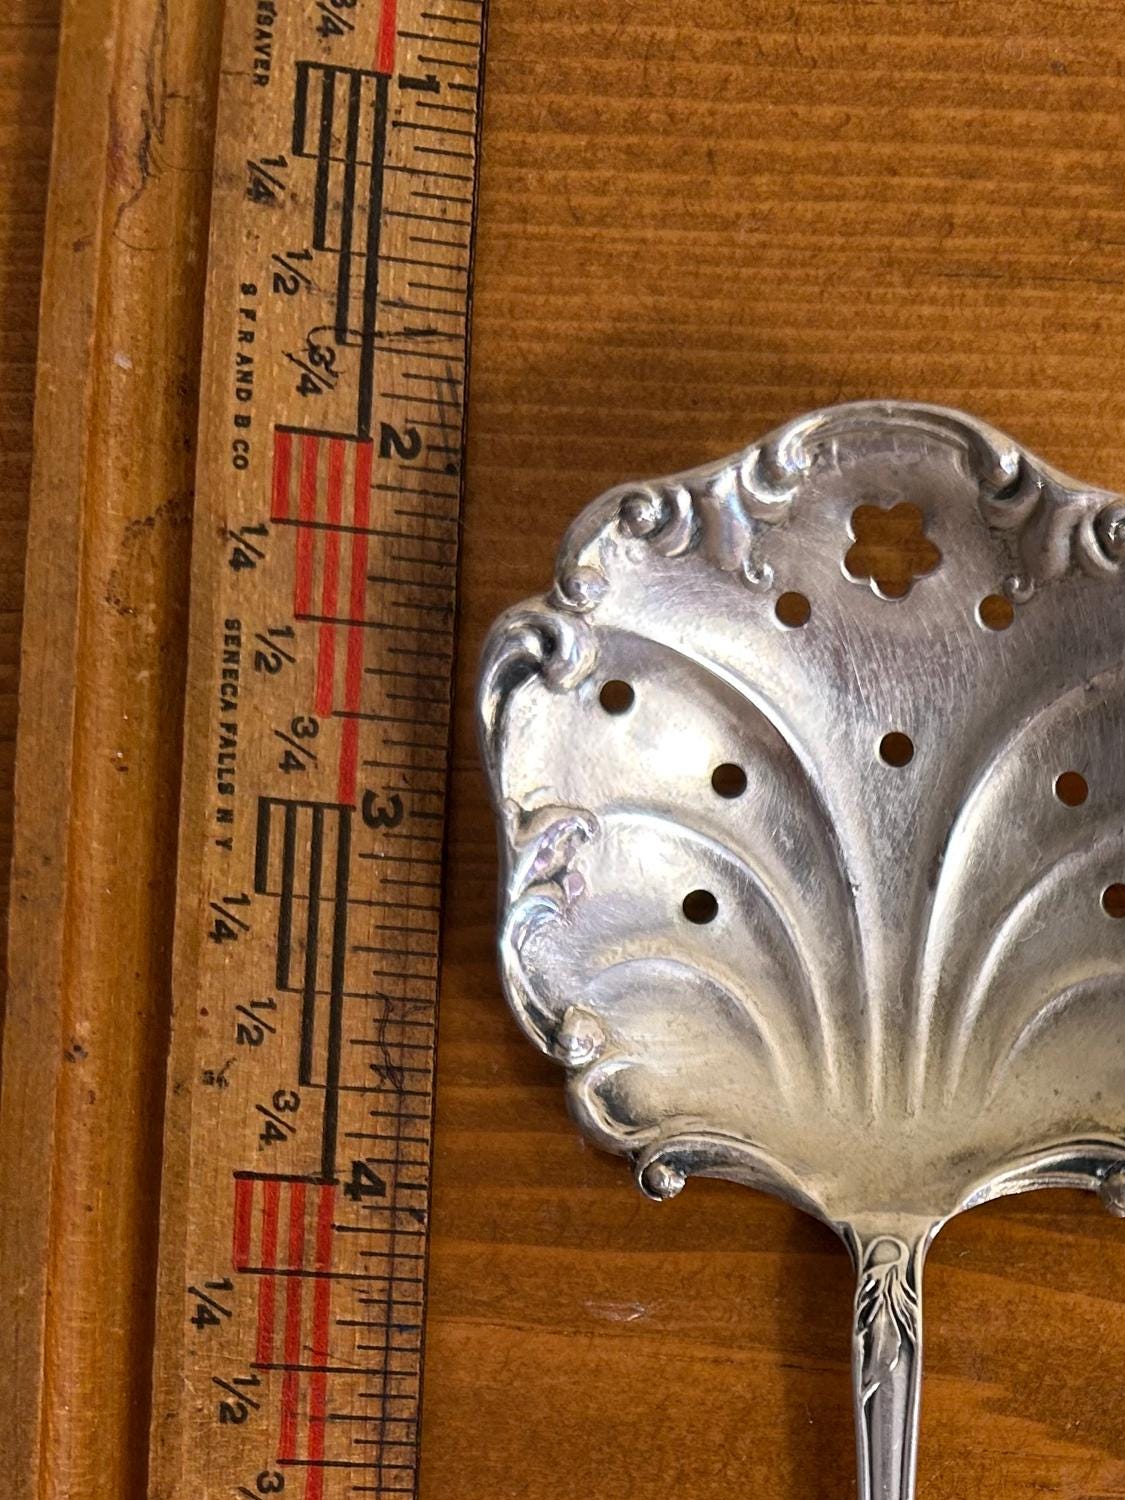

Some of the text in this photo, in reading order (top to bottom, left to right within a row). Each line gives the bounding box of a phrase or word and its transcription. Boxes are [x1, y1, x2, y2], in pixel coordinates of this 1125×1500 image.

[398, 75, 441, 94] 1
[247, 155, 288, 204] 1/4
[271, 249, 314, 296] 1/2
[238, 330, 255, 344] R
[239, 308, 257, 321] F
[235, 355, 255, 402] AND
[282, 346, 337, 398] 3/4
[233, 414, 251, 429] B
[378, 421, 423, 460] 2
[232, 439, 249, 471] CO
[228, 523, 270, 573] 1/4
[254, 624, 296, 675] 1/2
[215, 618, 242, 852] SENECA FALLS N Y
[274, 716, 320, 775] 3/4
[361, 789, 404, 830] 3
[208, 893, 251, 944] 1/4
[236, 997, 277, 1048] 1/2
[255, 1089, 301, 1146] 3/4
[343, 1160, 387, 1202] 4
[188, 1277, 234, 1330] 1/4
[211, 1374, 261, 1425] 1/2
